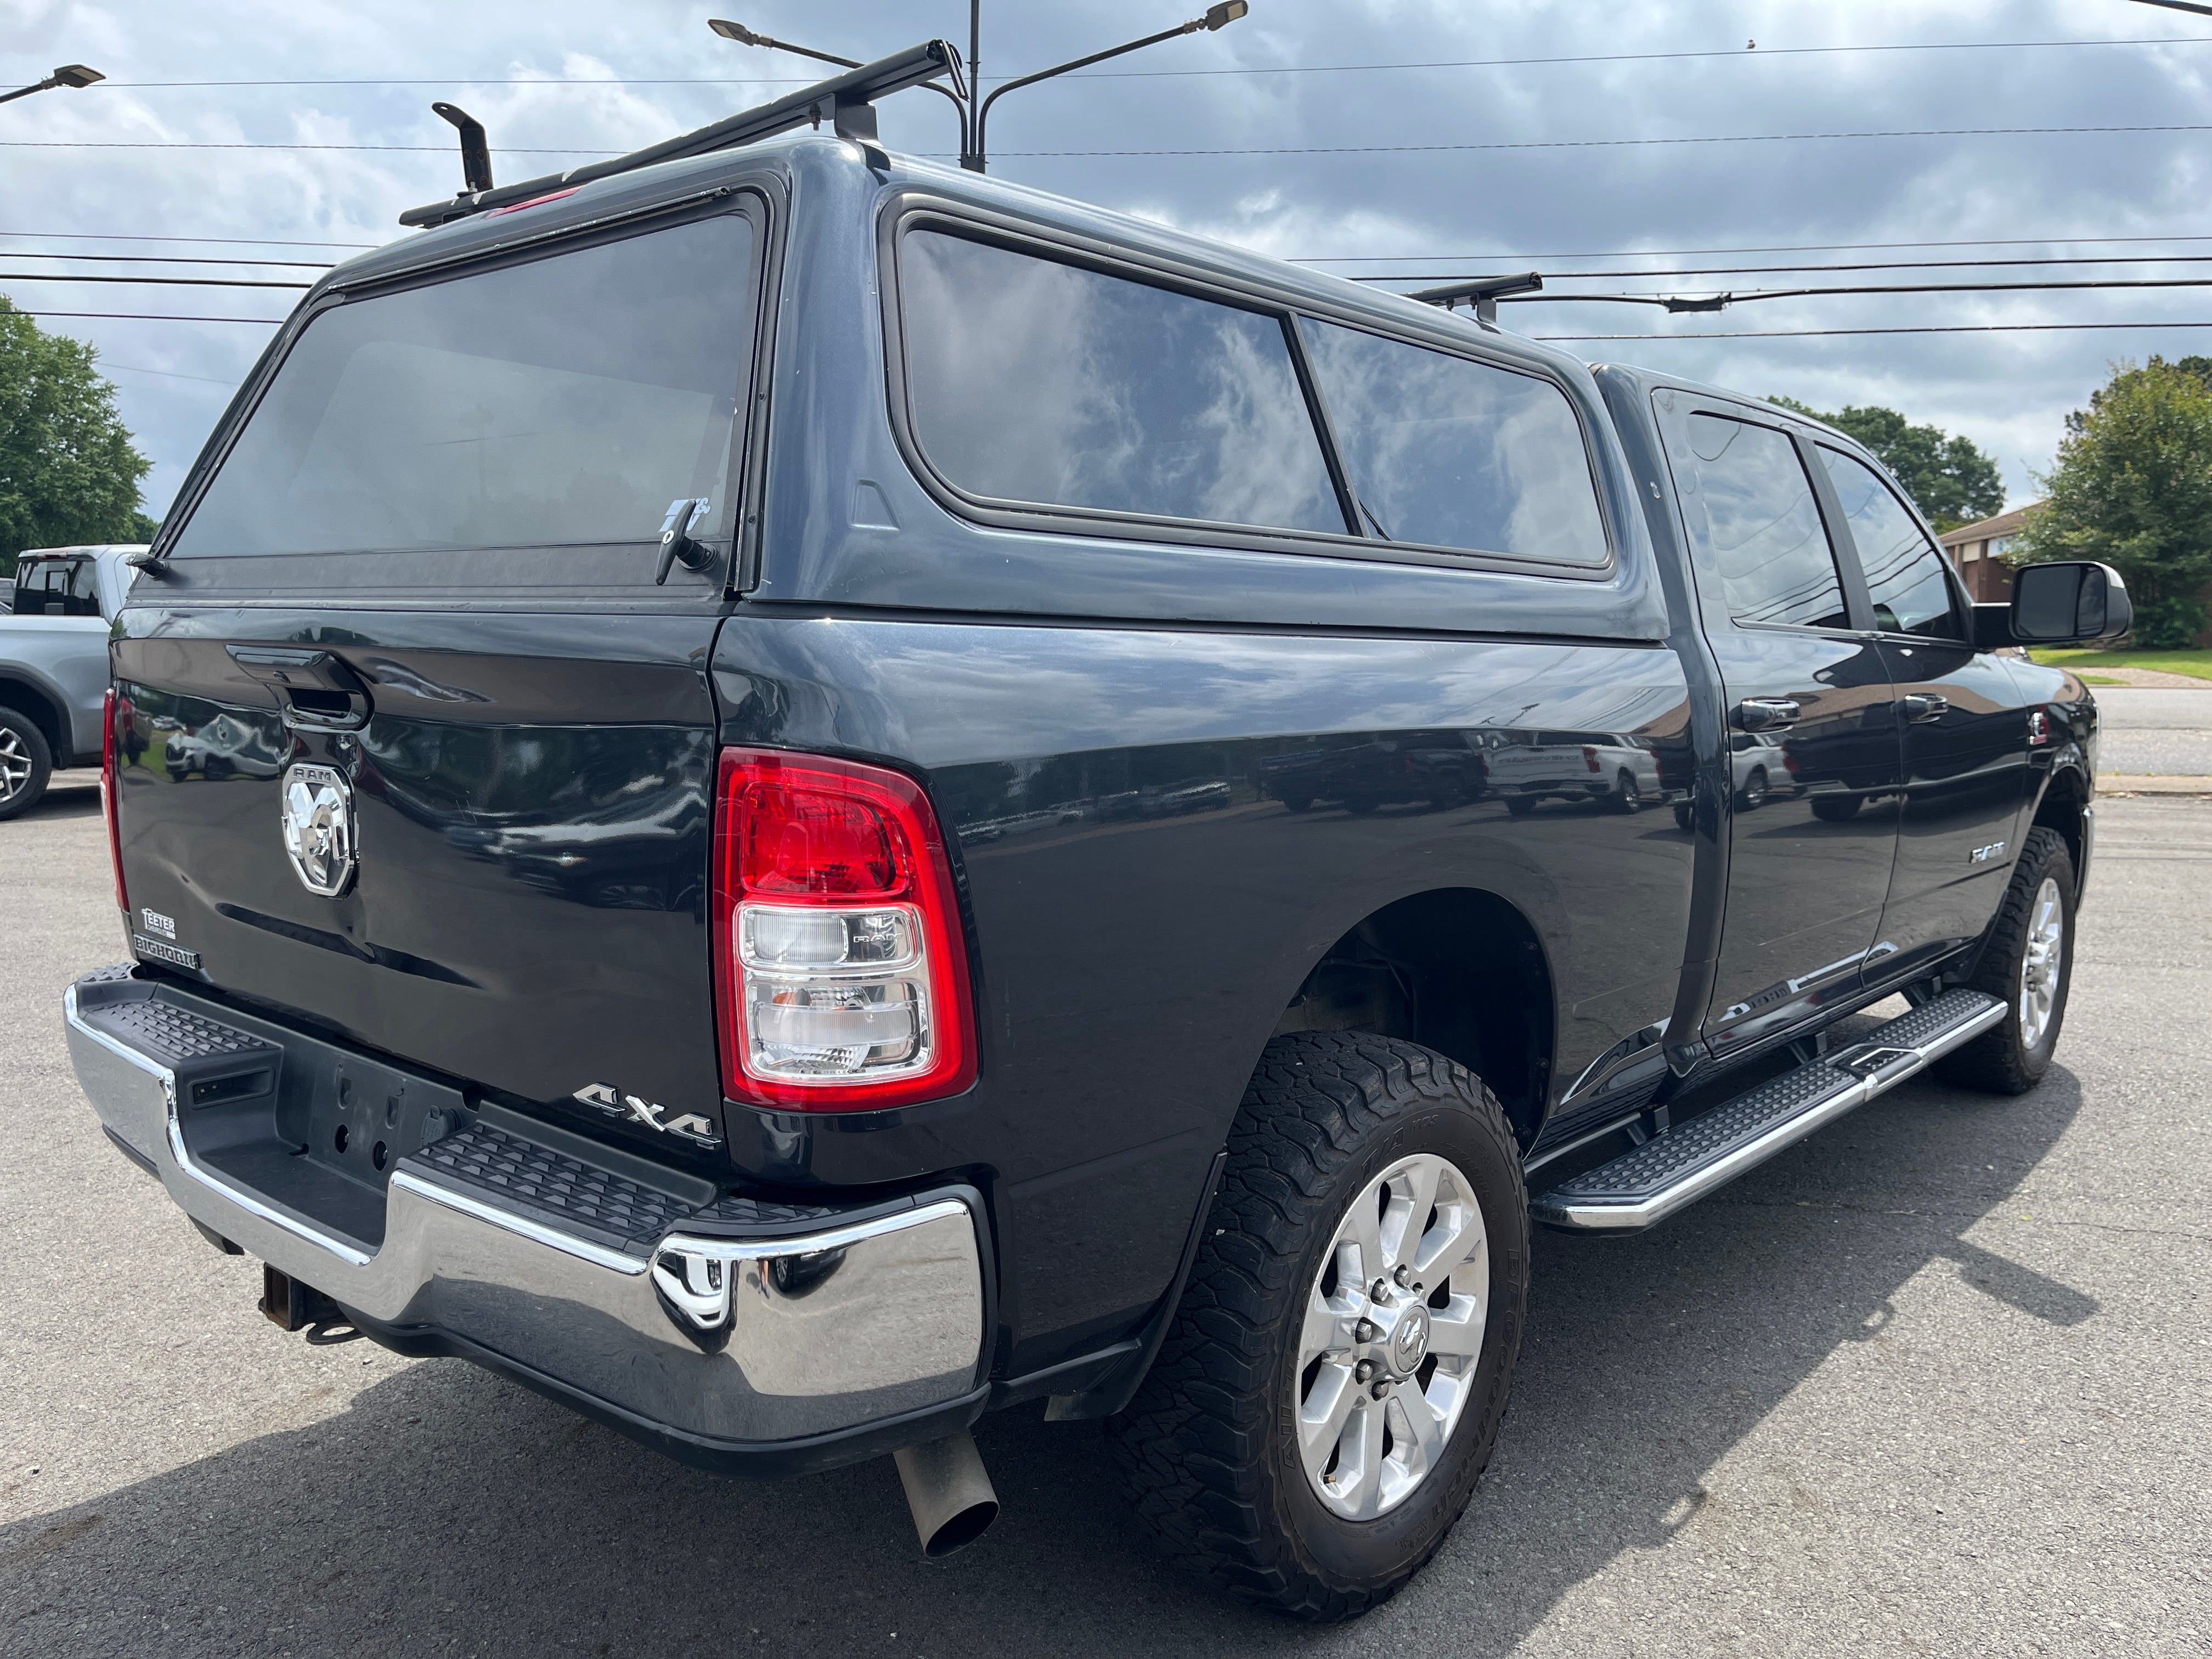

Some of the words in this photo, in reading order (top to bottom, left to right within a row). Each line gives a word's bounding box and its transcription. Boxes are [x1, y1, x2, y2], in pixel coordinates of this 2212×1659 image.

[293, 768, 331, 781] RAM
[142, 909, 176, 933] TEETER
[1361, 1126, 1404, 1181] T/A
[1431, 1248, 1520, 1522] BFGoodrich
